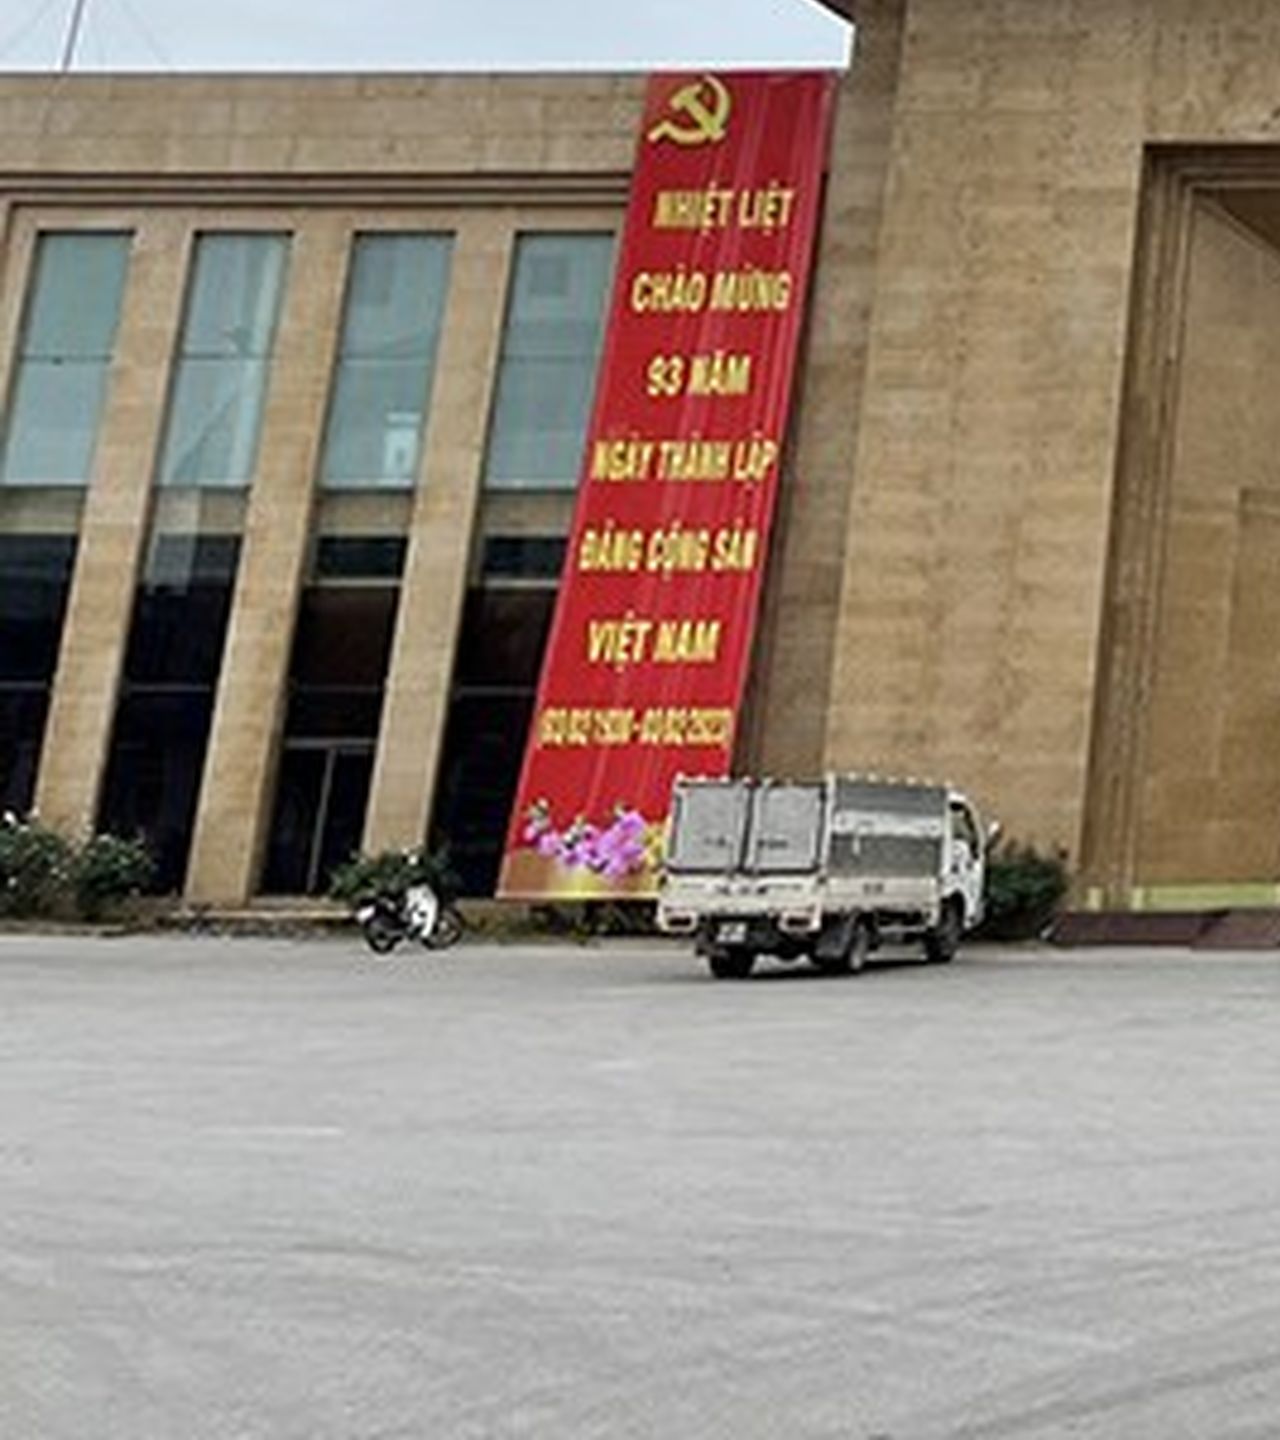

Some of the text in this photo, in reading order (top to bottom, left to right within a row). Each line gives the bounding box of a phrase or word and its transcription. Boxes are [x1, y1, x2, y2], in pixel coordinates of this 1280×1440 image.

[653, 180, 795, 237] NHIỆT LIỆT
[632, 262, 707, 312] CHÀO
[647, 349, 751, 396] 93 NĂM
[587, 611, 721, 673] VIỆT NAM
